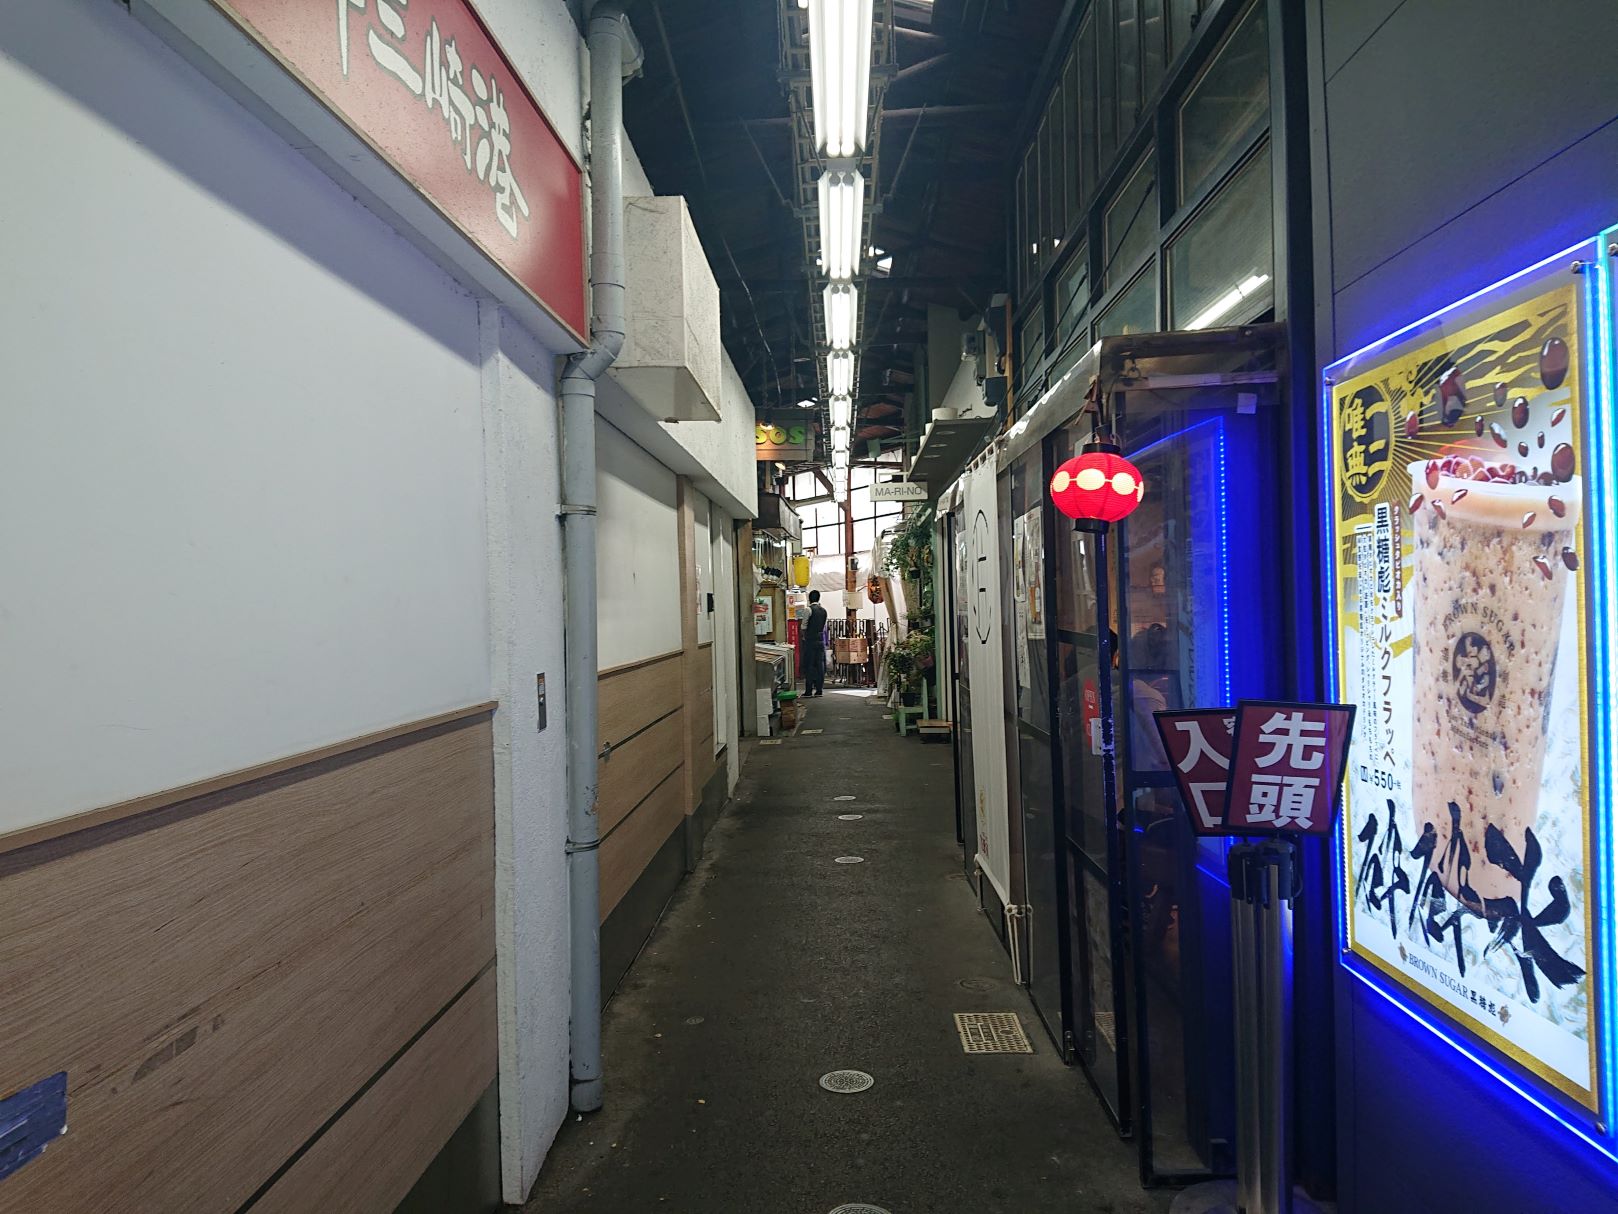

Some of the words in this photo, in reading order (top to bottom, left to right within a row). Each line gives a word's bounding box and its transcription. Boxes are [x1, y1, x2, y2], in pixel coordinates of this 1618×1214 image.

[875, 486, 922, 497] MA-RI-NO
[1246, 711, 1327, 830] 先頭
[1408, 952, 1438, 980] BROWN
[1439, 971, 1469, 999] SUGAR
